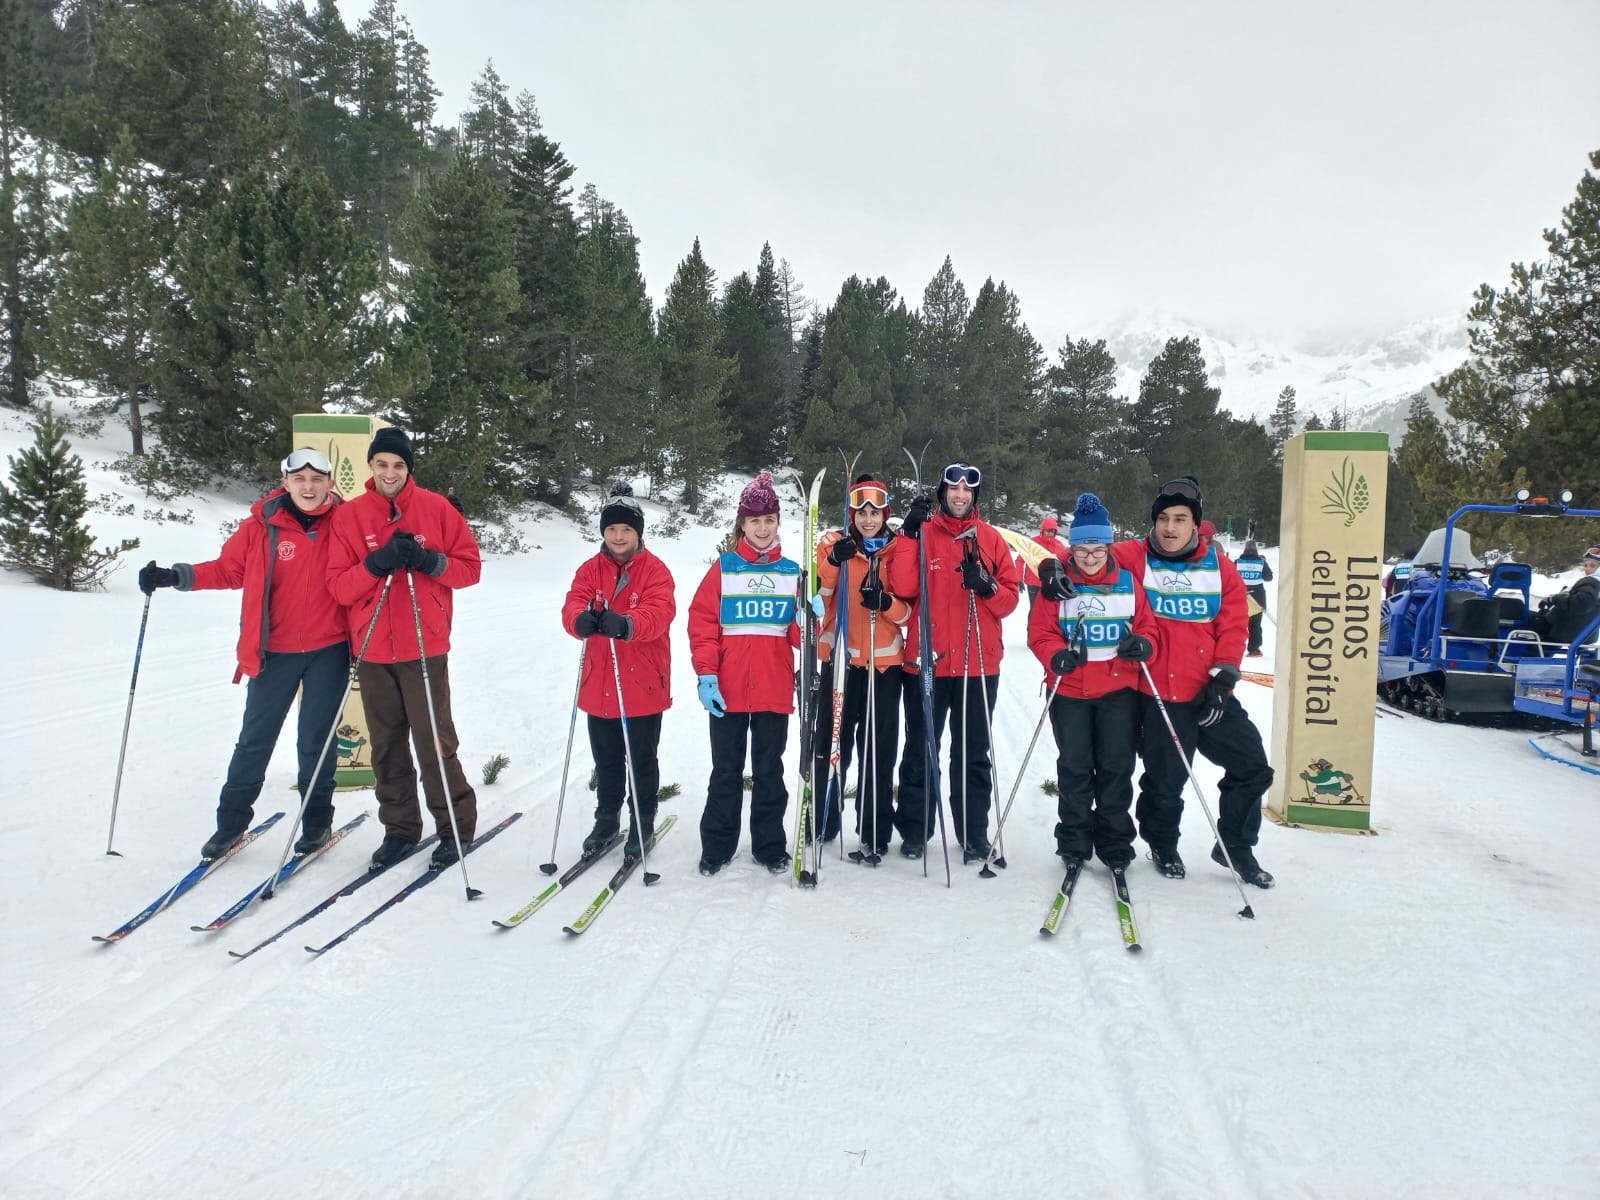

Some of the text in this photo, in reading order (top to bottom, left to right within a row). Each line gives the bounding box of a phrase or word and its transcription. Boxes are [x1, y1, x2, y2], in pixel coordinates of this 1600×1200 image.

[736, 600, 788, 620] 1087
[1156, 596, 1209, 615] 1089
[1342, 555, 1380, 660] Llanos
[1300, 591, 1340, 726] Hospital
